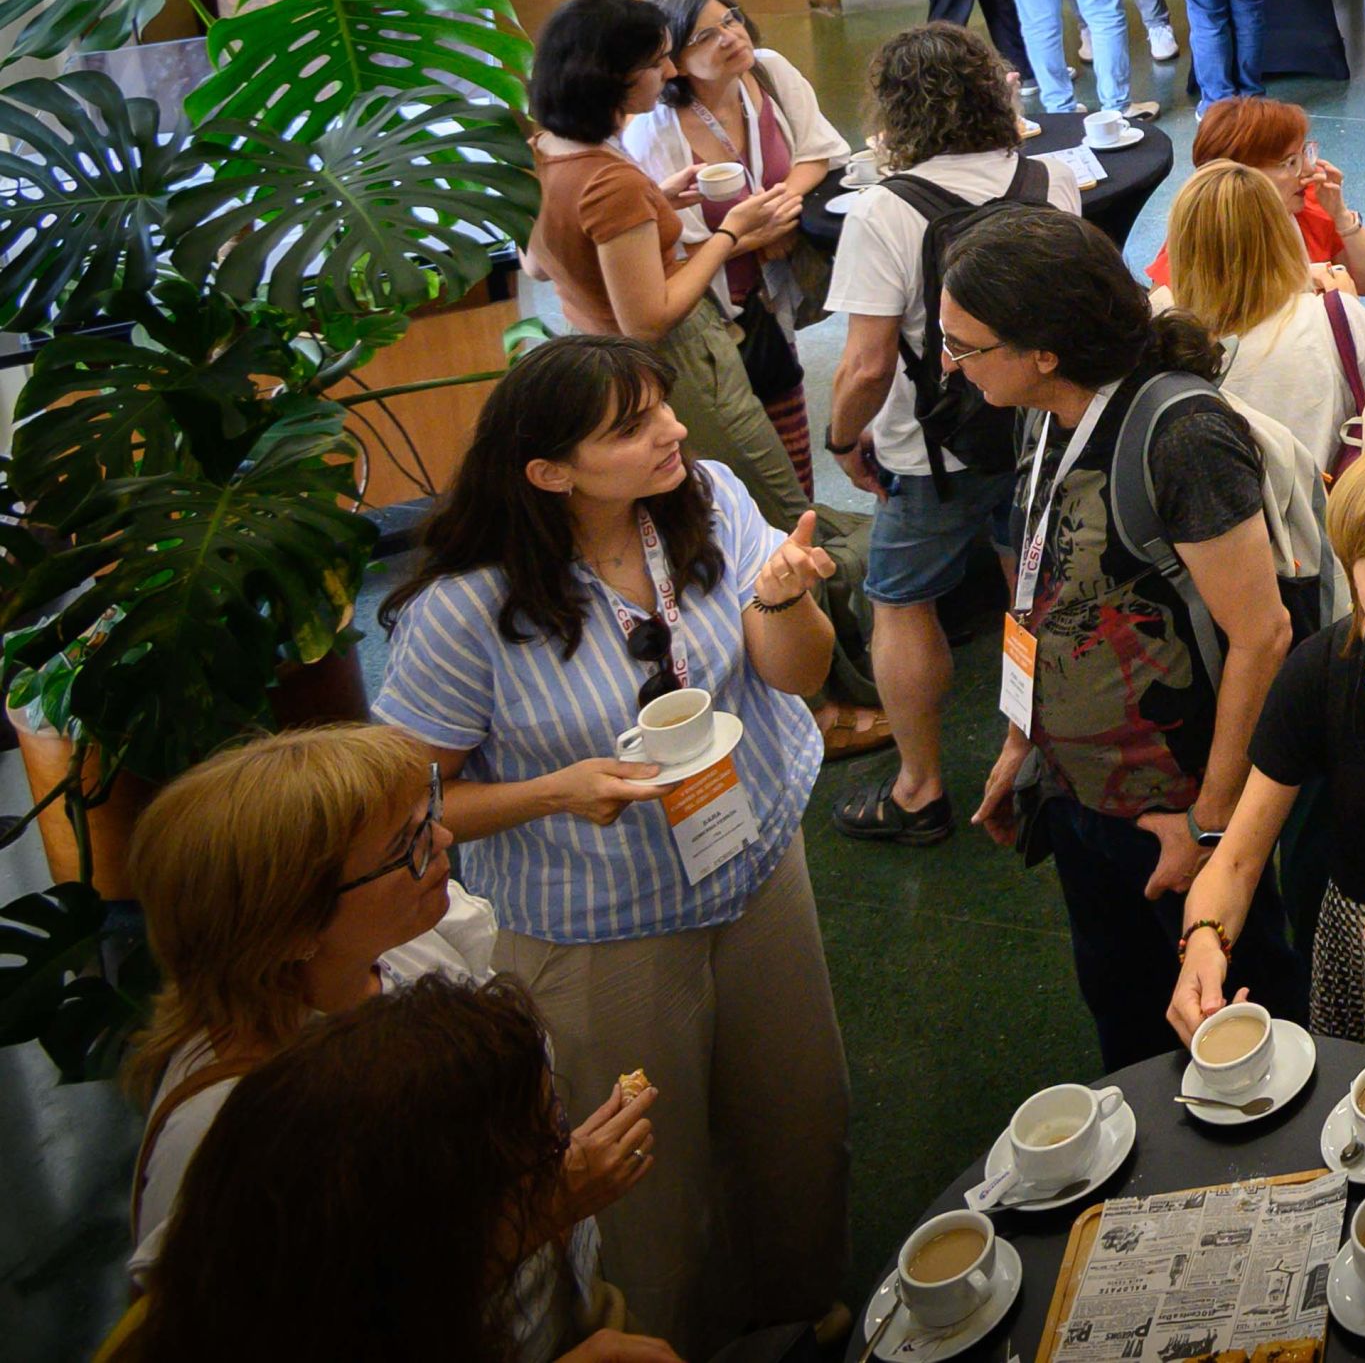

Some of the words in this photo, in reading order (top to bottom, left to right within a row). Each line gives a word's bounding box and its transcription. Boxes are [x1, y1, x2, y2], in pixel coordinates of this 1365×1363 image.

[1027, 534, 1043, 572] CSIC
[659, 581, 679, 623] CSIC
[617, 608, 634, 632] CS
[1158, 1313, 1173, 1321] Day
[1180, 1310, 1201, 1319] Cents
